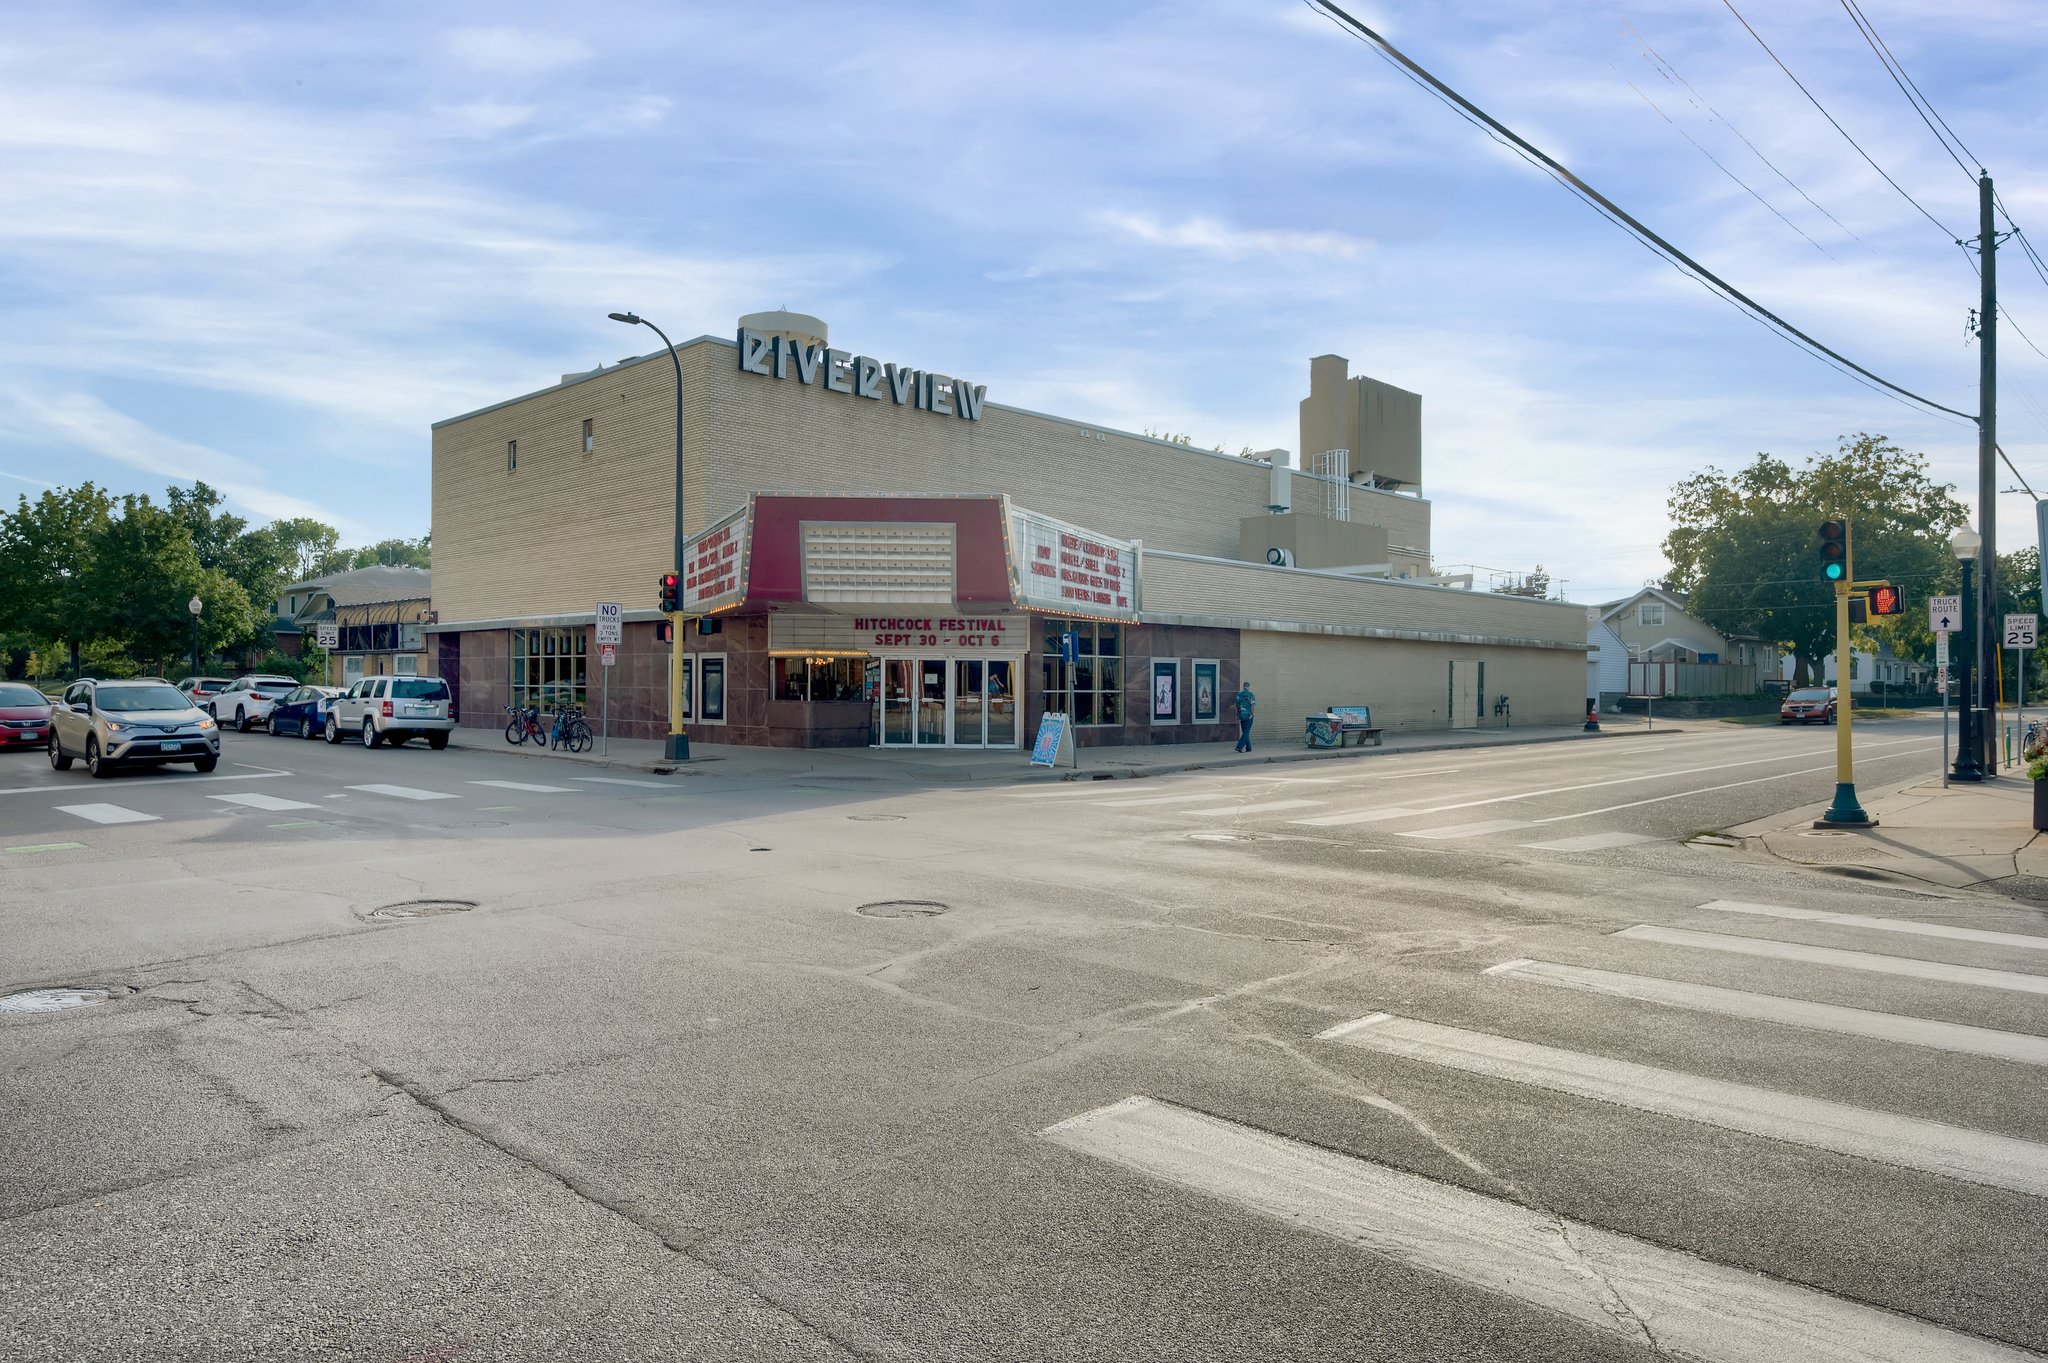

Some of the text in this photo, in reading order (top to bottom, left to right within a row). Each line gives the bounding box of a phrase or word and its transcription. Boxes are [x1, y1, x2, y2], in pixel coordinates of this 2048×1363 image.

[737, 327, 987, 421] RIVERVIEW
[1932, 598, 1958, 606] TRUCK
[602, 605, 617, 616] NO
[855, 618, 1006, 631] HITCHCOCK FESTIVAL
[319, 636, 337, 645] 25
[874, 634, 912, 646] SEPT
[919, 634, 937, 646] 30
[958, 634, 985, 646] OCT
[991, 634, 1000, 646] 6
[2007, 632, 2035, 645] 25
